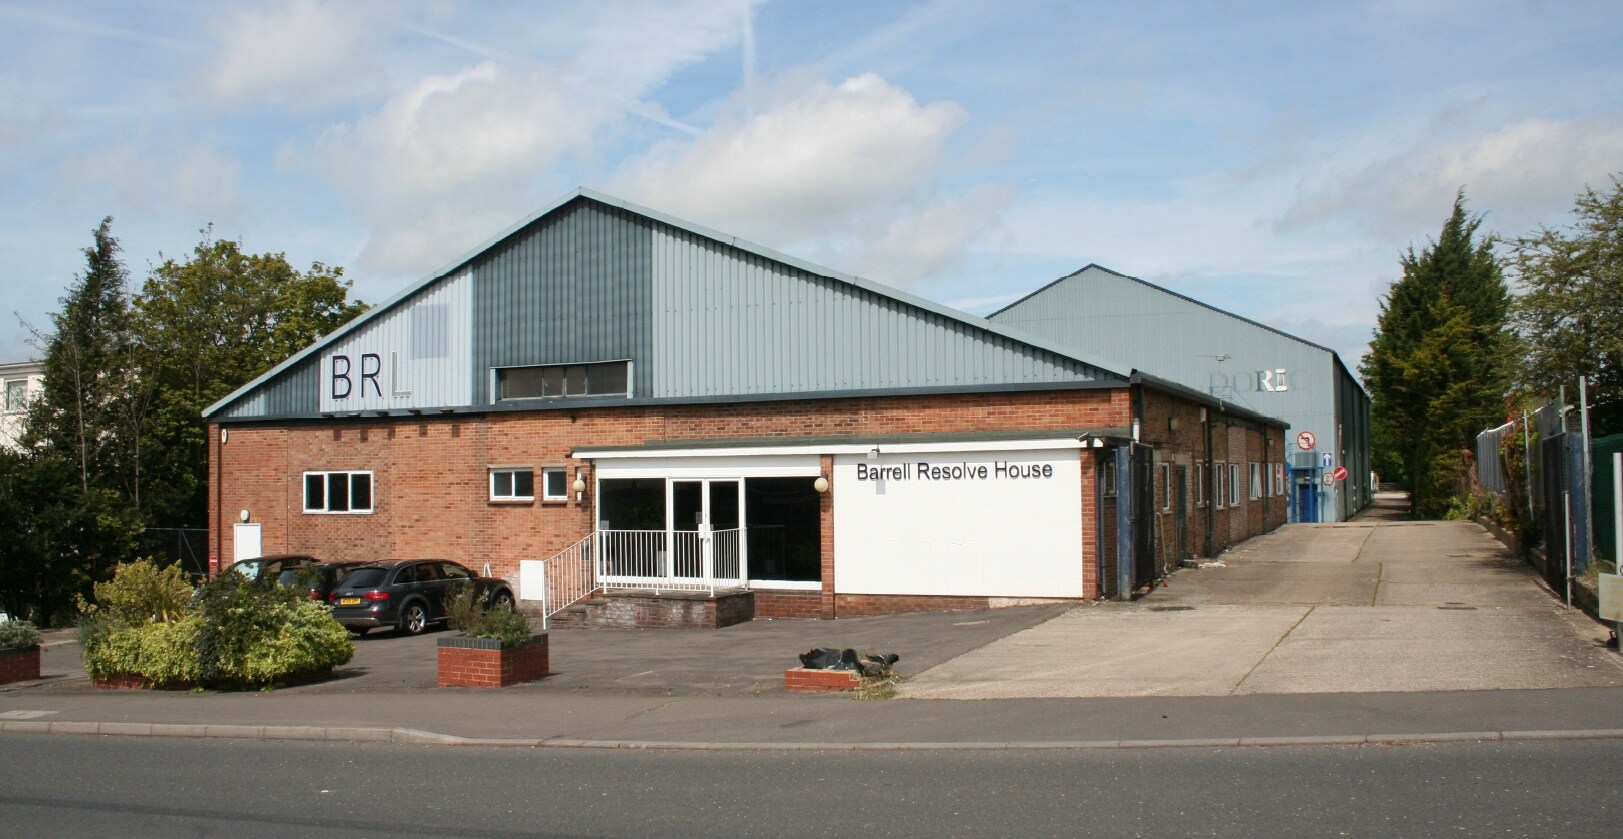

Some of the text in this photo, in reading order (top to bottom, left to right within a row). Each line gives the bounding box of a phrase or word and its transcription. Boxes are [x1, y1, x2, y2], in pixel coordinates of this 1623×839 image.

[332, 351, 412, 399] BRL
[857, 461, 1053, 480] Barrell Resolve House
